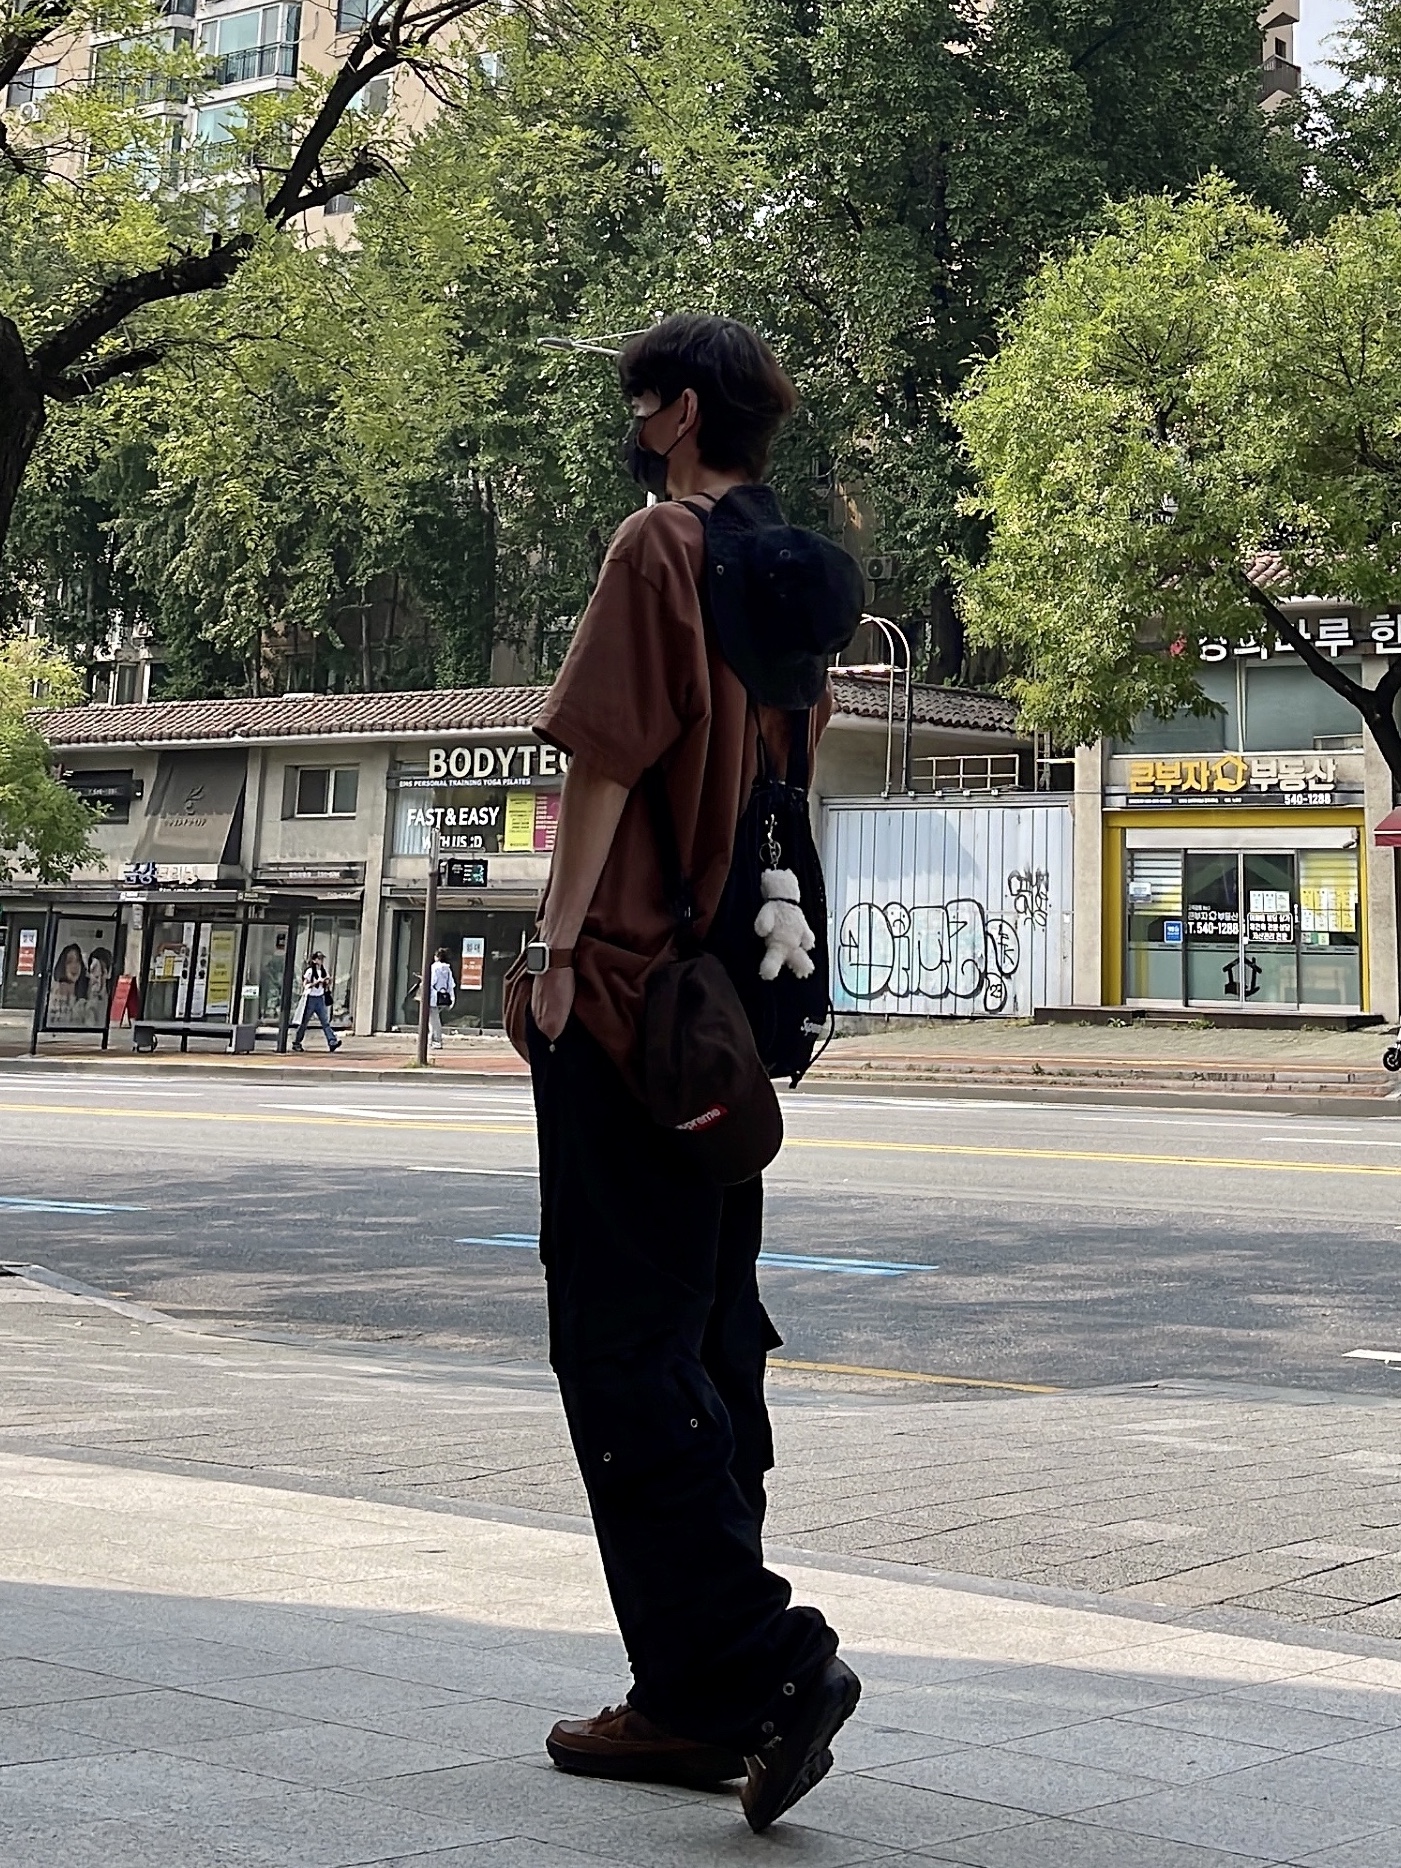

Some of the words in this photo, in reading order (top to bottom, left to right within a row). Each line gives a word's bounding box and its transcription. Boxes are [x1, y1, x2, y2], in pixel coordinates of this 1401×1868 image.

[414, 779, 447, 787] PERSONAL
[449, 778, 481, 786] TRAINING
[483, 778, 502, 786] YOGA
[503, 777, 531, 785] PILATES
[1130, 760, 1210, 793] 큰부자
[1249, 758, 1337, 792] 부동산
[1284, 793, 1331, 805] 540-1288
[990, 984, 1002, 998] 23
[674, 1108, 721, 1130] upreme
